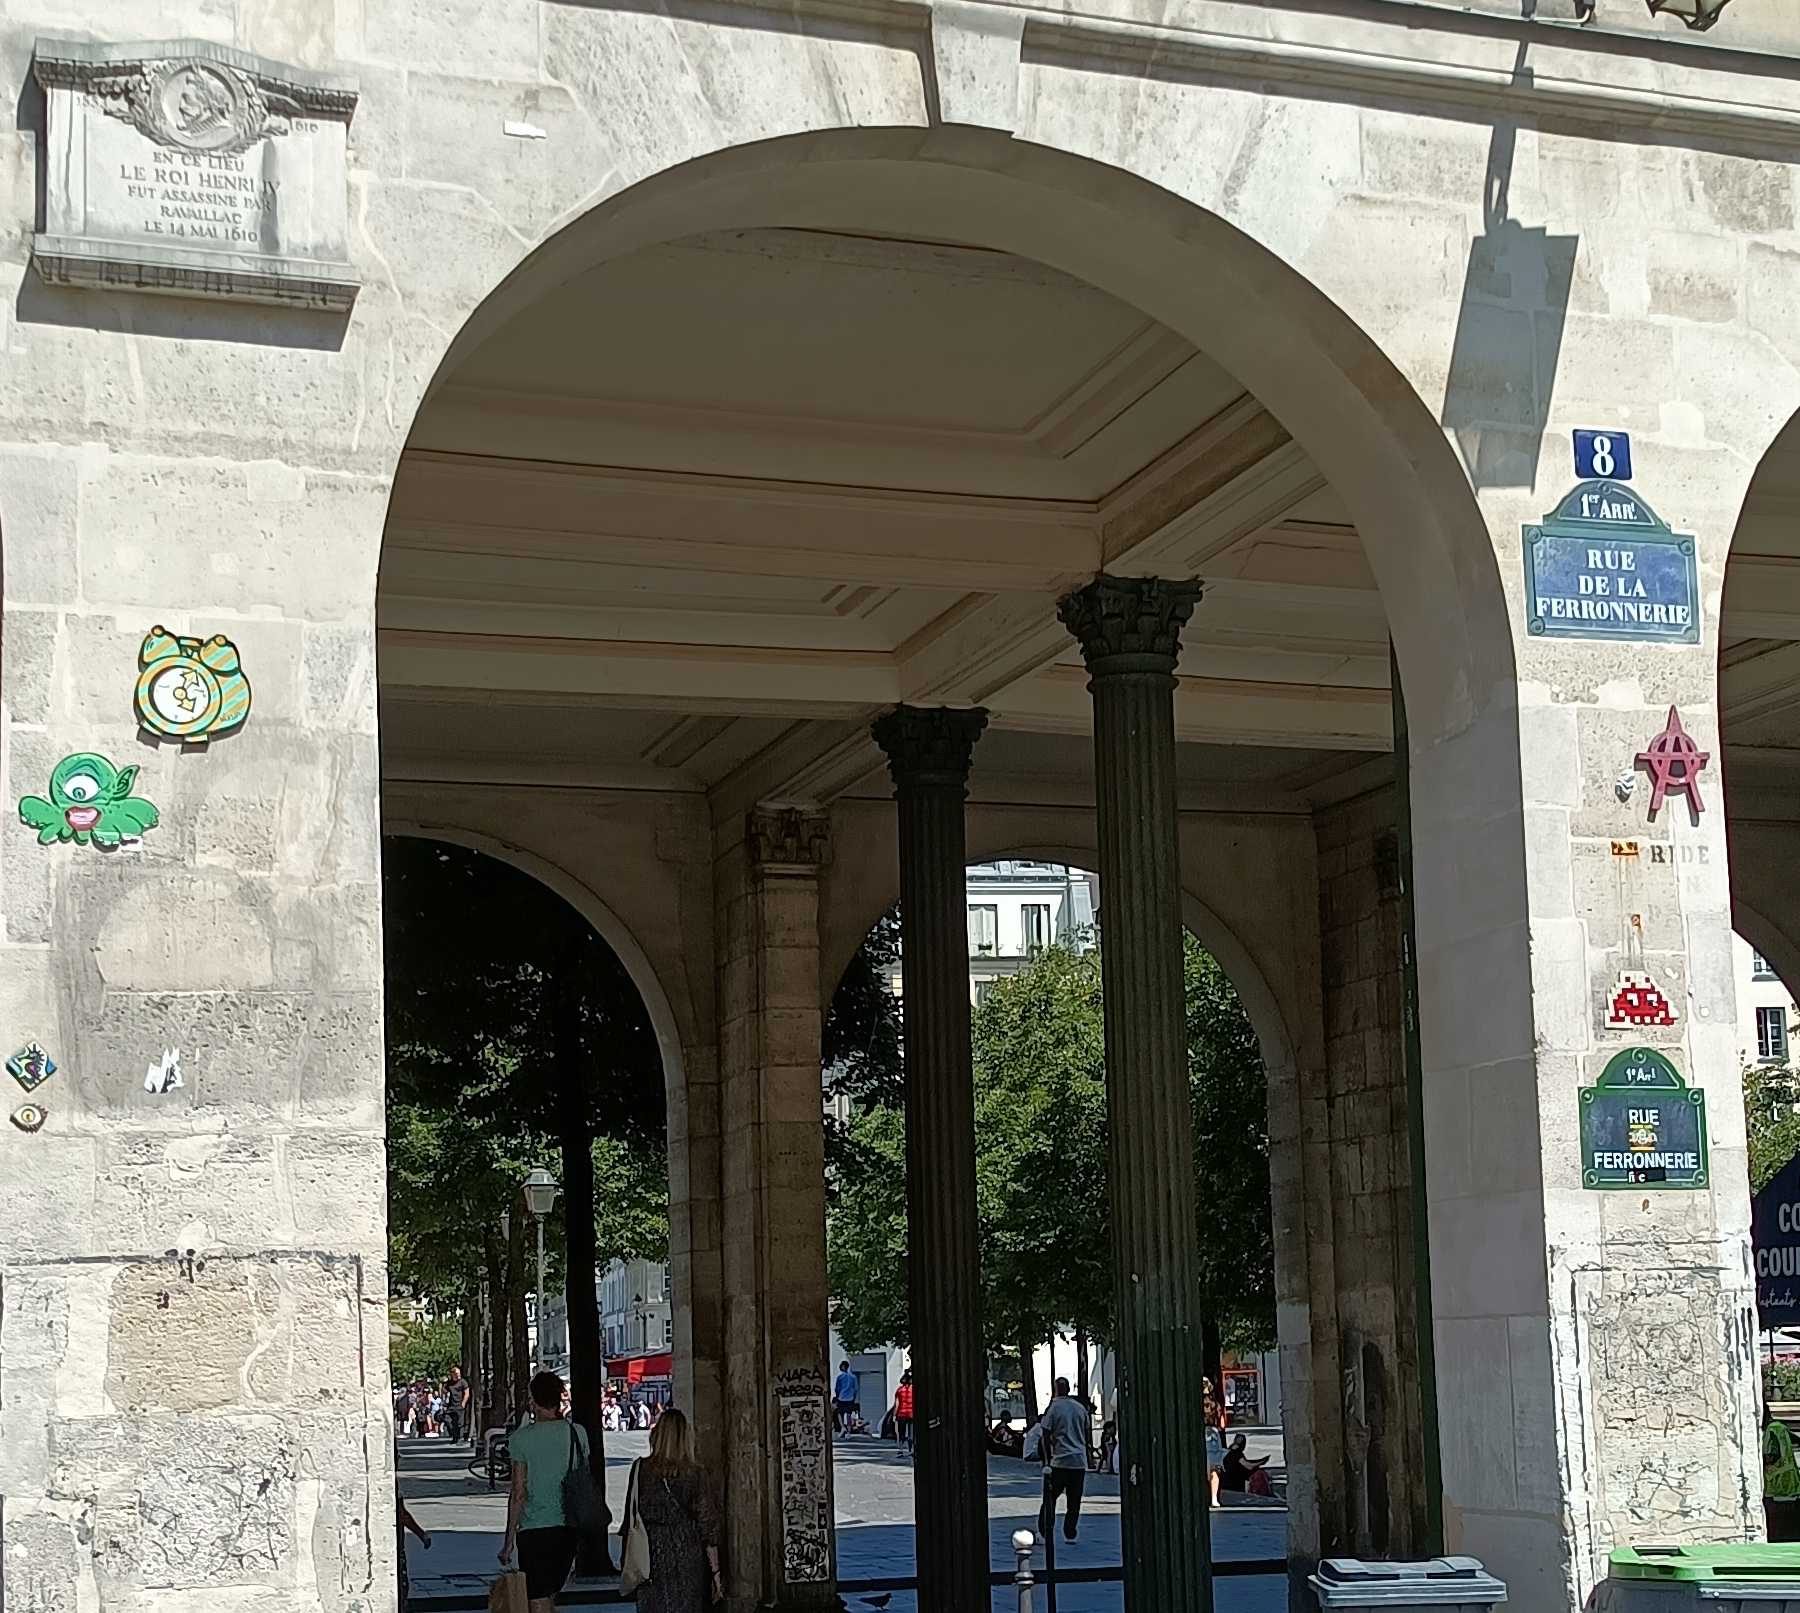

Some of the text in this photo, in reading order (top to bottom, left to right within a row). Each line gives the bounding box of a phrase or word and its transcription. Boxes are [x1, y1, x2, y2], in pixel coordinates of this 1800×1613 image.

[153, 151, 245, 172] EN CE LIEU
[120, 164, 280, 195] LE ROI HENRI IV
[127, 185, 156, 199] FUT
[244, 197, 272, 212] PAR
[160, 204, 242, 225] RAVAILLAC
[144, 220, 258, 243] LE 14 MAI 1610
[1592, 435, 1615, 476] 8
[1587, 549, 1636, 571] RUE
[1578, 575, 1648, 598] DE LA
[1536, 597, 1691, 625] FERRONNERIE
[1628, 1108, 1660, 1126] RUE
[1593, 1151, 1698, 1169] FERRONNERIE
